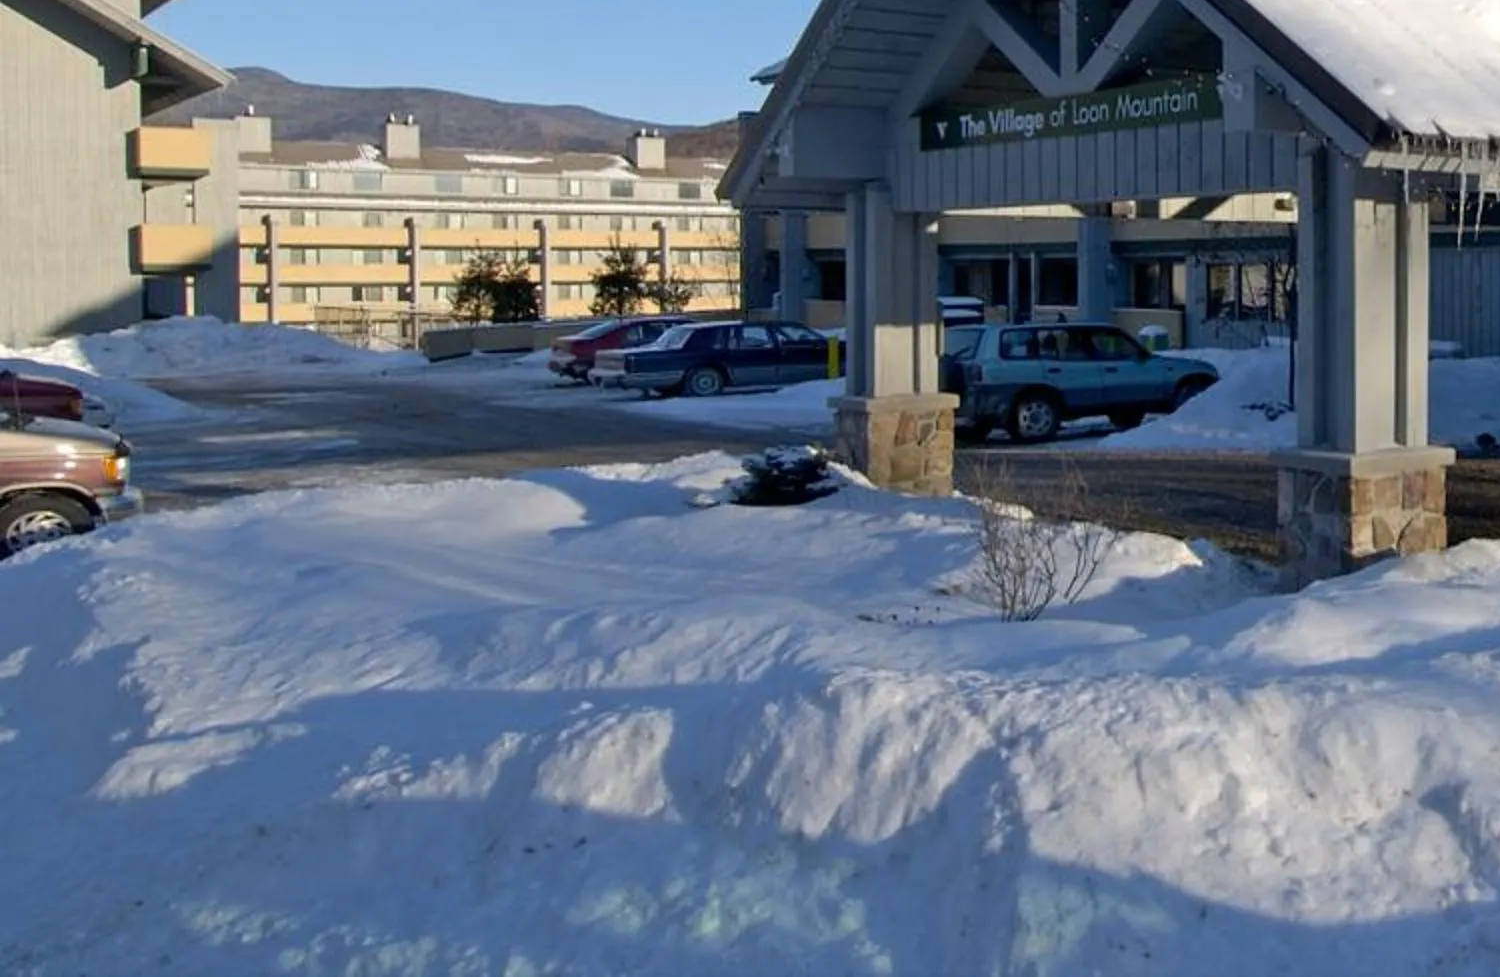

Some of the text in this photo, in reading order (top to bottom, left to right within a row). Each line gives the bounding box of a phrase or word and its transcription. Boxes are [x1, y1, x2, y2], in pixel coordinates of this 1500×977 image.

[959, 88, 1198, 138] The Village of Loon Mountain
